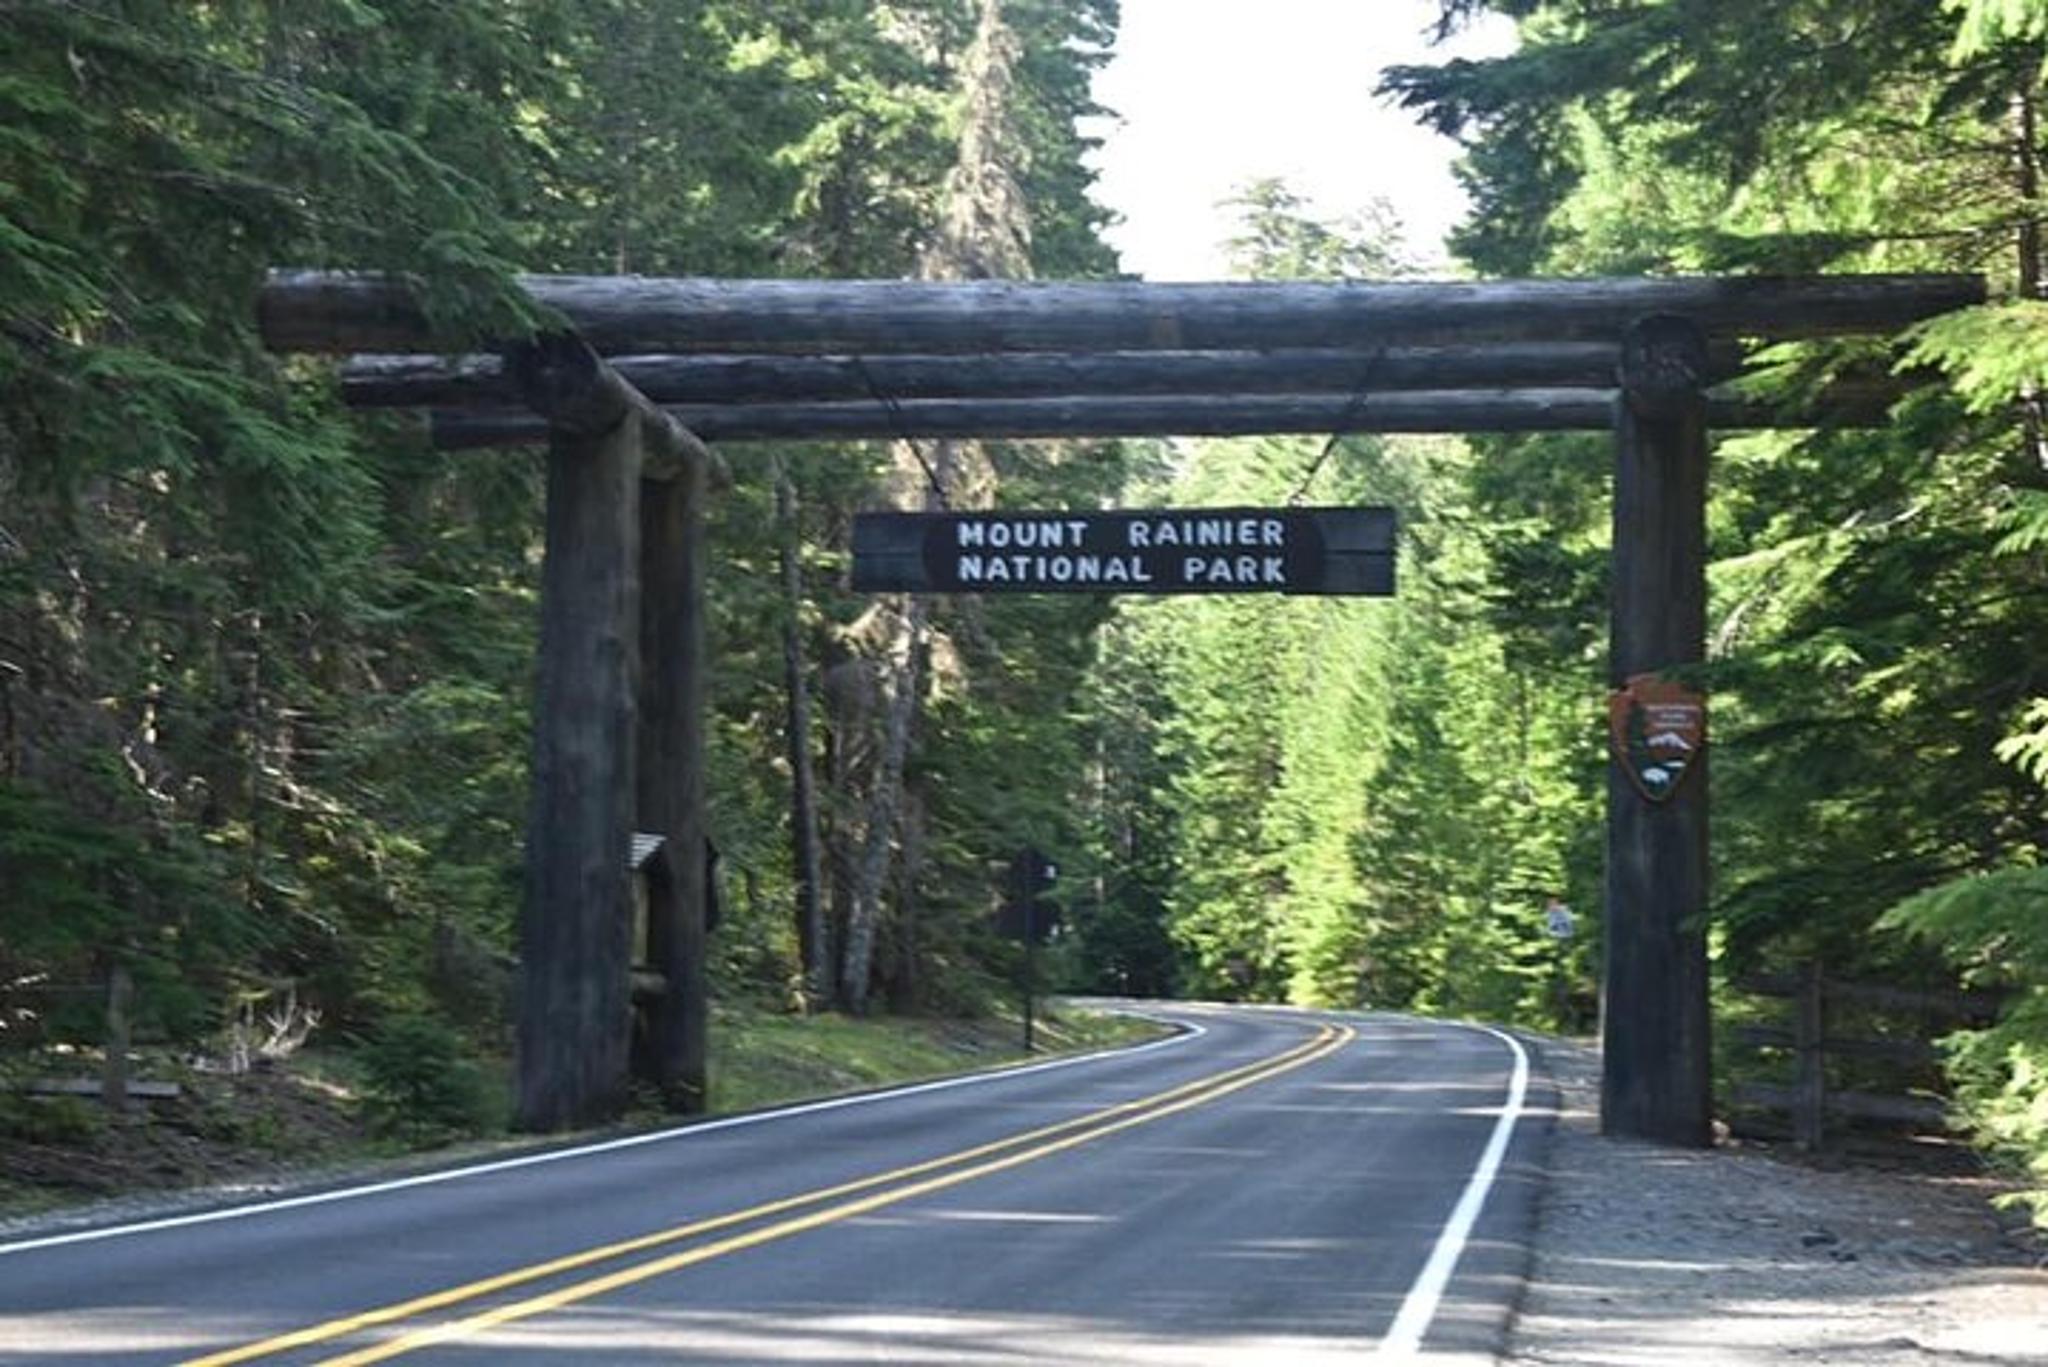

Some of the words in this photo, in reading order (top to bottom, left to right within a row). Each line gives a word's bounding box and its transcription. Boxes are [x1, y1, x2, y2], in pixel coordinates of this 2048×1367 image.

[958, 521, 1088, 546] MOUNT
[1129, 520, 1285, 546] RAINIER
[959, 557, 1151, 581] NATIONAL
[1185, 557, 1286, 582] PARK
